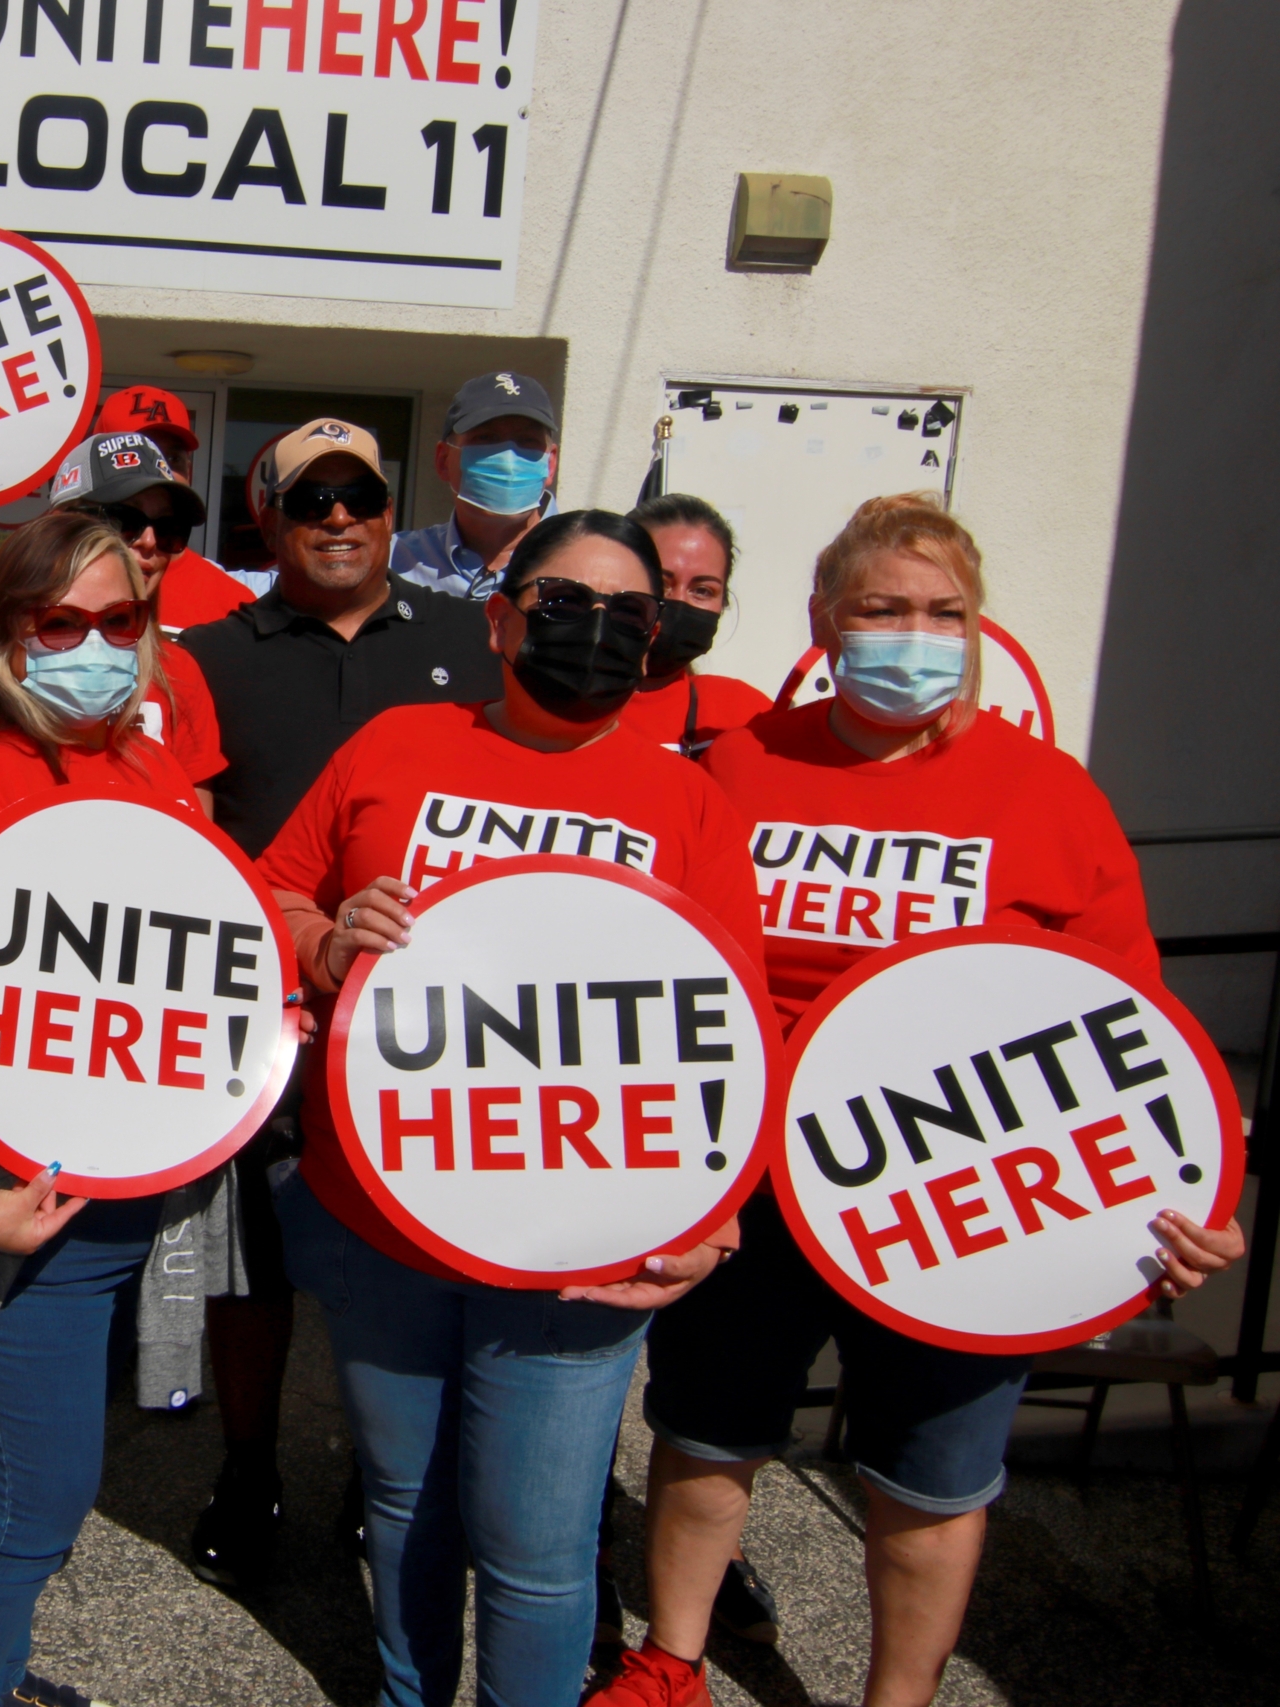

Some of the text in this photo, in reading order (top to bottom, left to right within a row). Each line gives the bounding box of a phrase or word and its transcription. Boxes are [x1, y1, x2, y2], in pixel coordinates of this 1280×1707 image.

[421, 119, 509, 218] 11
[98, 433, 143, 457] SUPER
[129, 392, 172, 423] LA
[425, 798, 649, 875] UNITE
[752, 828, 982, 889] UNITE
[373, 976, 734, 1072] UNITE
[378, 1078, 728, 1172] HERE!
[796, 997, 1169, 1188] UNITE
[838, 1093, 1203, 1287] HERE!
